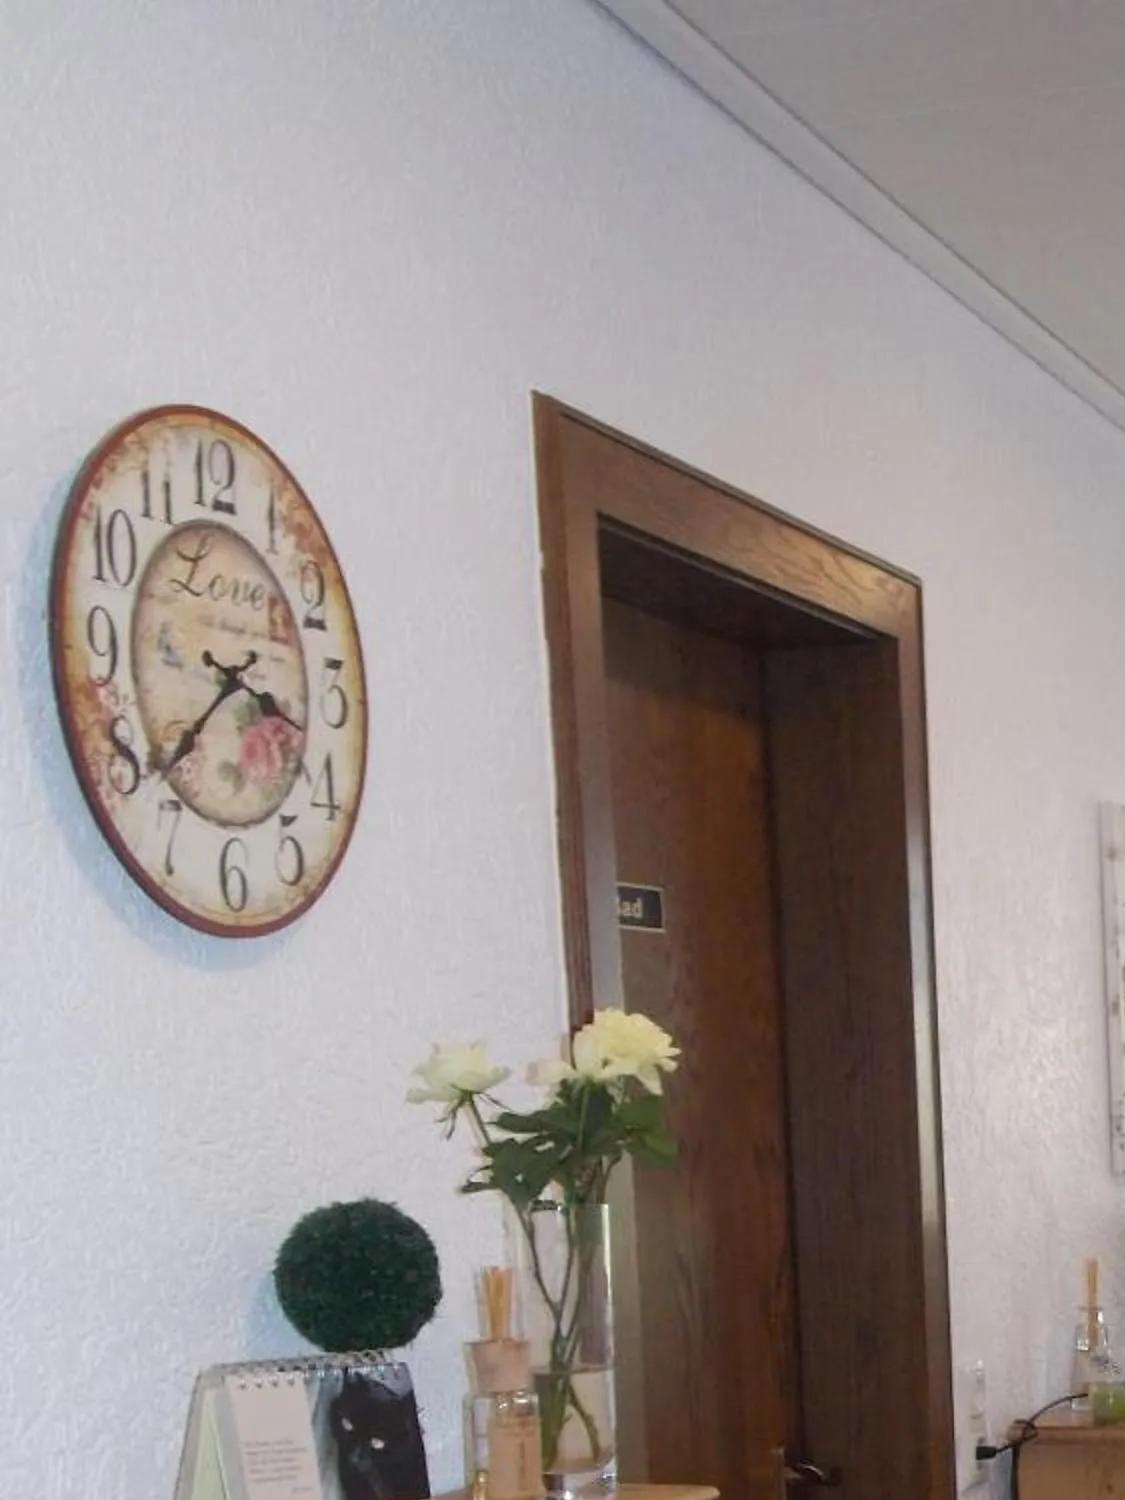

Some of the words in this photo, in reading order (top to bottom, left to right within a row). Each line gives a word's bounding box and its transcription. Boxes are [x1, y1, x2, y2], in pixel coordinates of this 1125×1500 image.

[139, 464, 174, 526] 11
[193, 438, 237, 516] 12
[92, 502, 138, 588] 10
[264, 484, 280, 557] 1
[167, 533, 266, 612] Love
[300, 559, 329, 633] 2
[87, 605, 118, 686] 9
[320, 657, 349, 730] 3
[108, 714, 141, 796] 8
[309, 752, 343, 823] 4
[157, 799, 184, 877] 7
[218, 836, 249, 913] 6
[274, 813, 305, 887] 5
